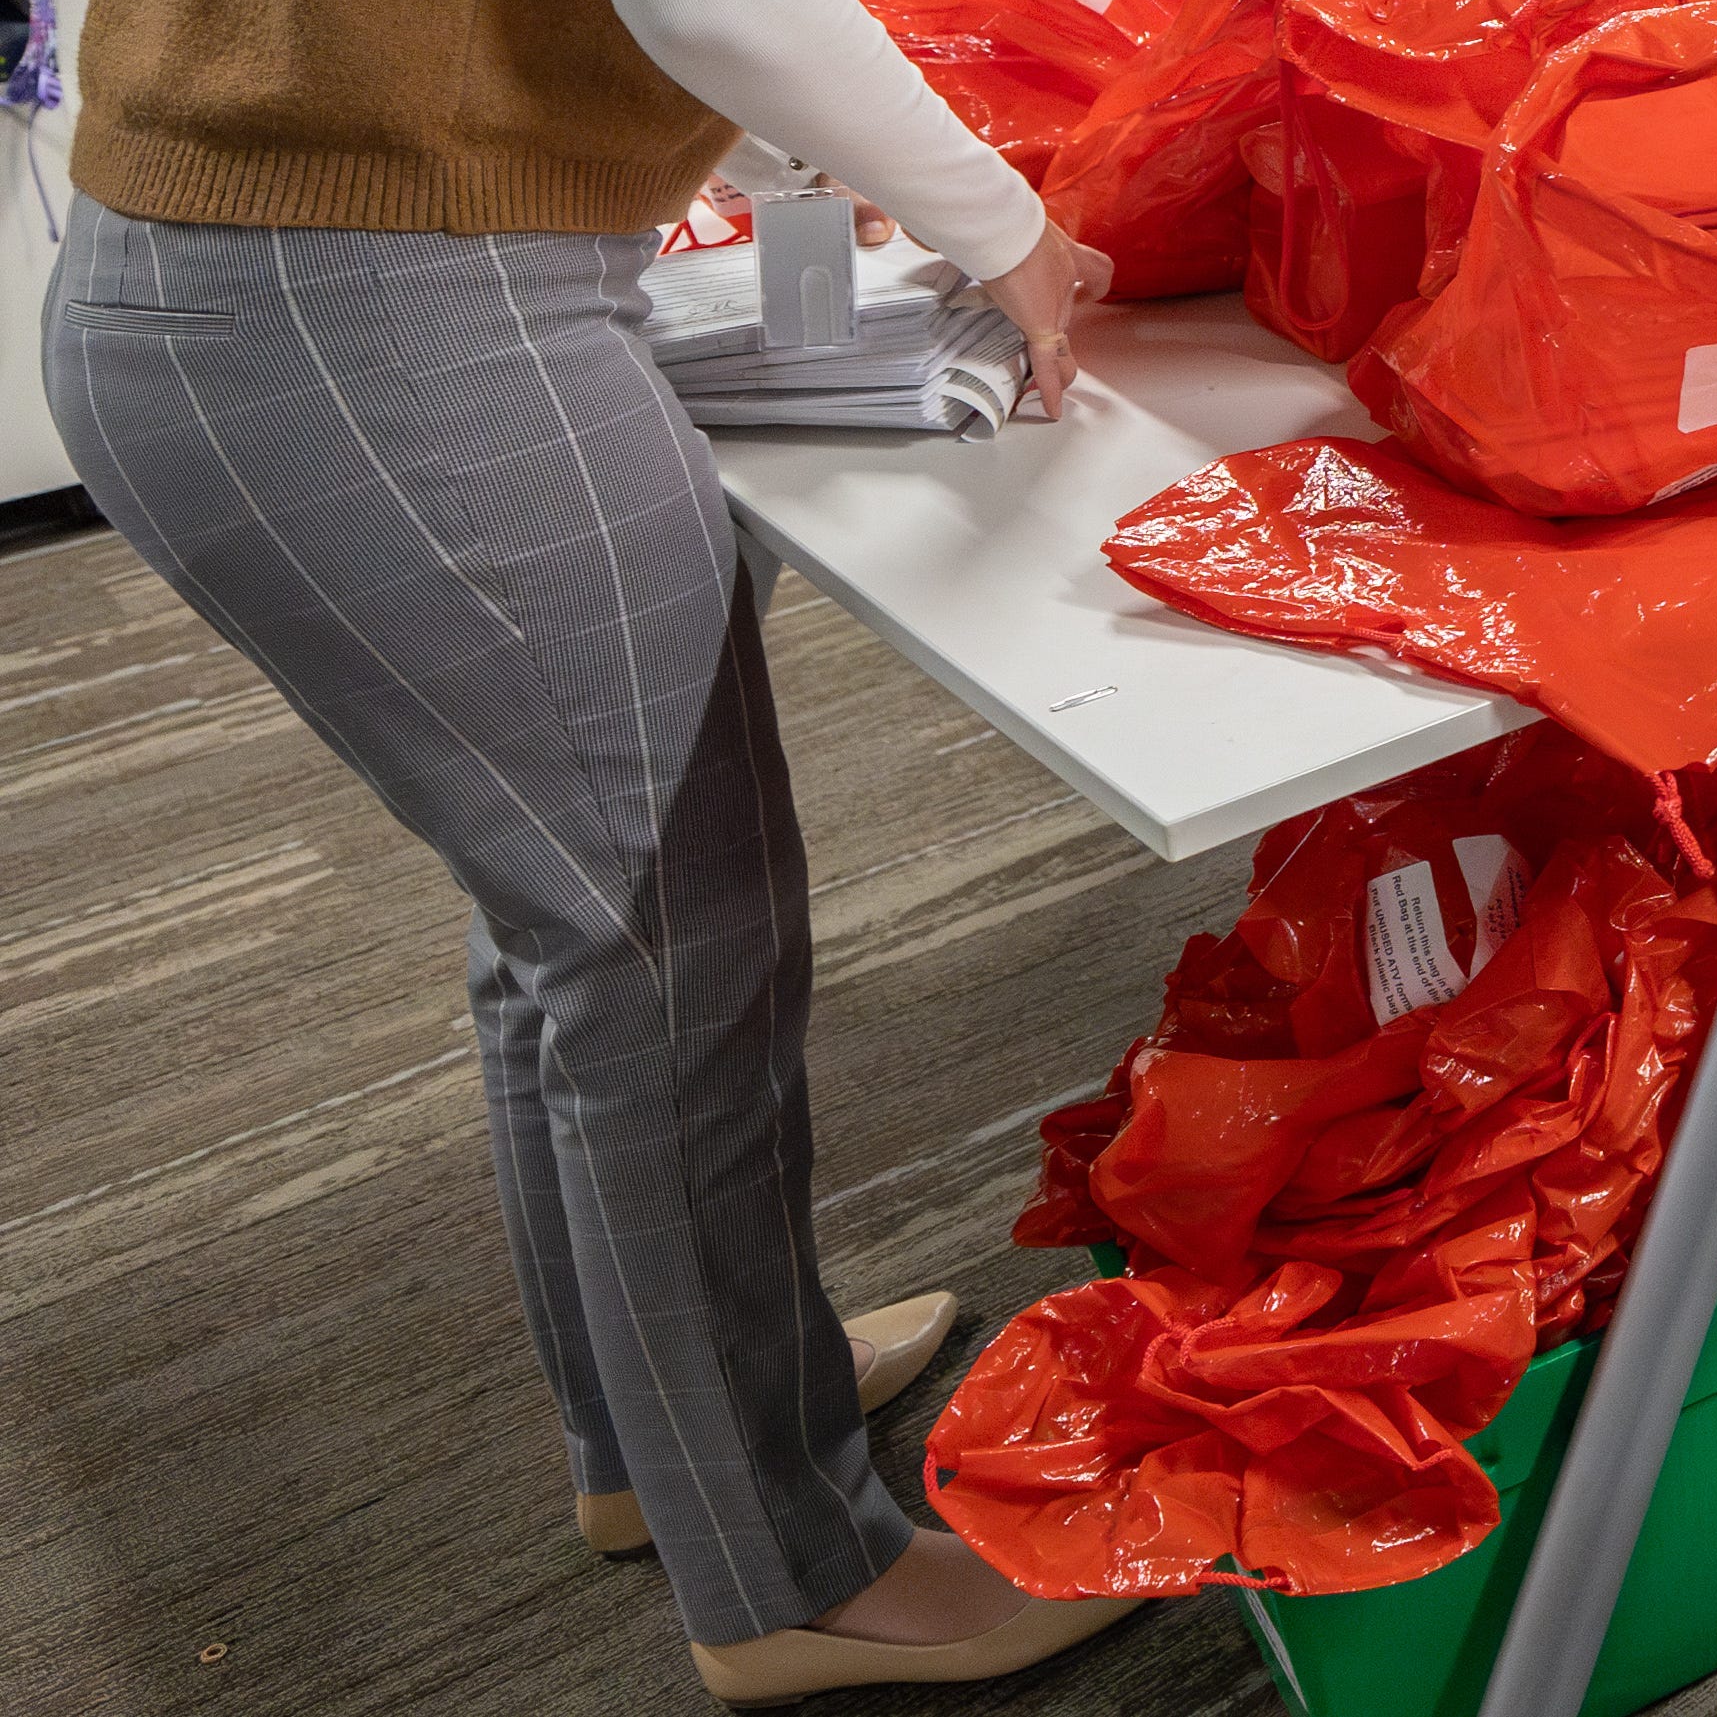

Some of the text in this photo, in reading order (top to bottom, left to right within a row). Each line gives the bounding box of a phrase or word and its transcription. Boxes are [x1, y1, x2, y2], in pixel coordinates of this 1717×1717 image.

[1368, 924, 1380, 952] Black
[1374, 956, 1390, 994] plastic
[1371, 887, 1414, 1012] Put UNUSED ATV forms
[1392, 875, 1441, 1003] Red Bag at the end of the
[1411, 896, 1425, 935] Return
[1420, 935, 1430, 957] this
[1427, 957, 1441, 979] bag
[1437, 977, 1447, 988] in
